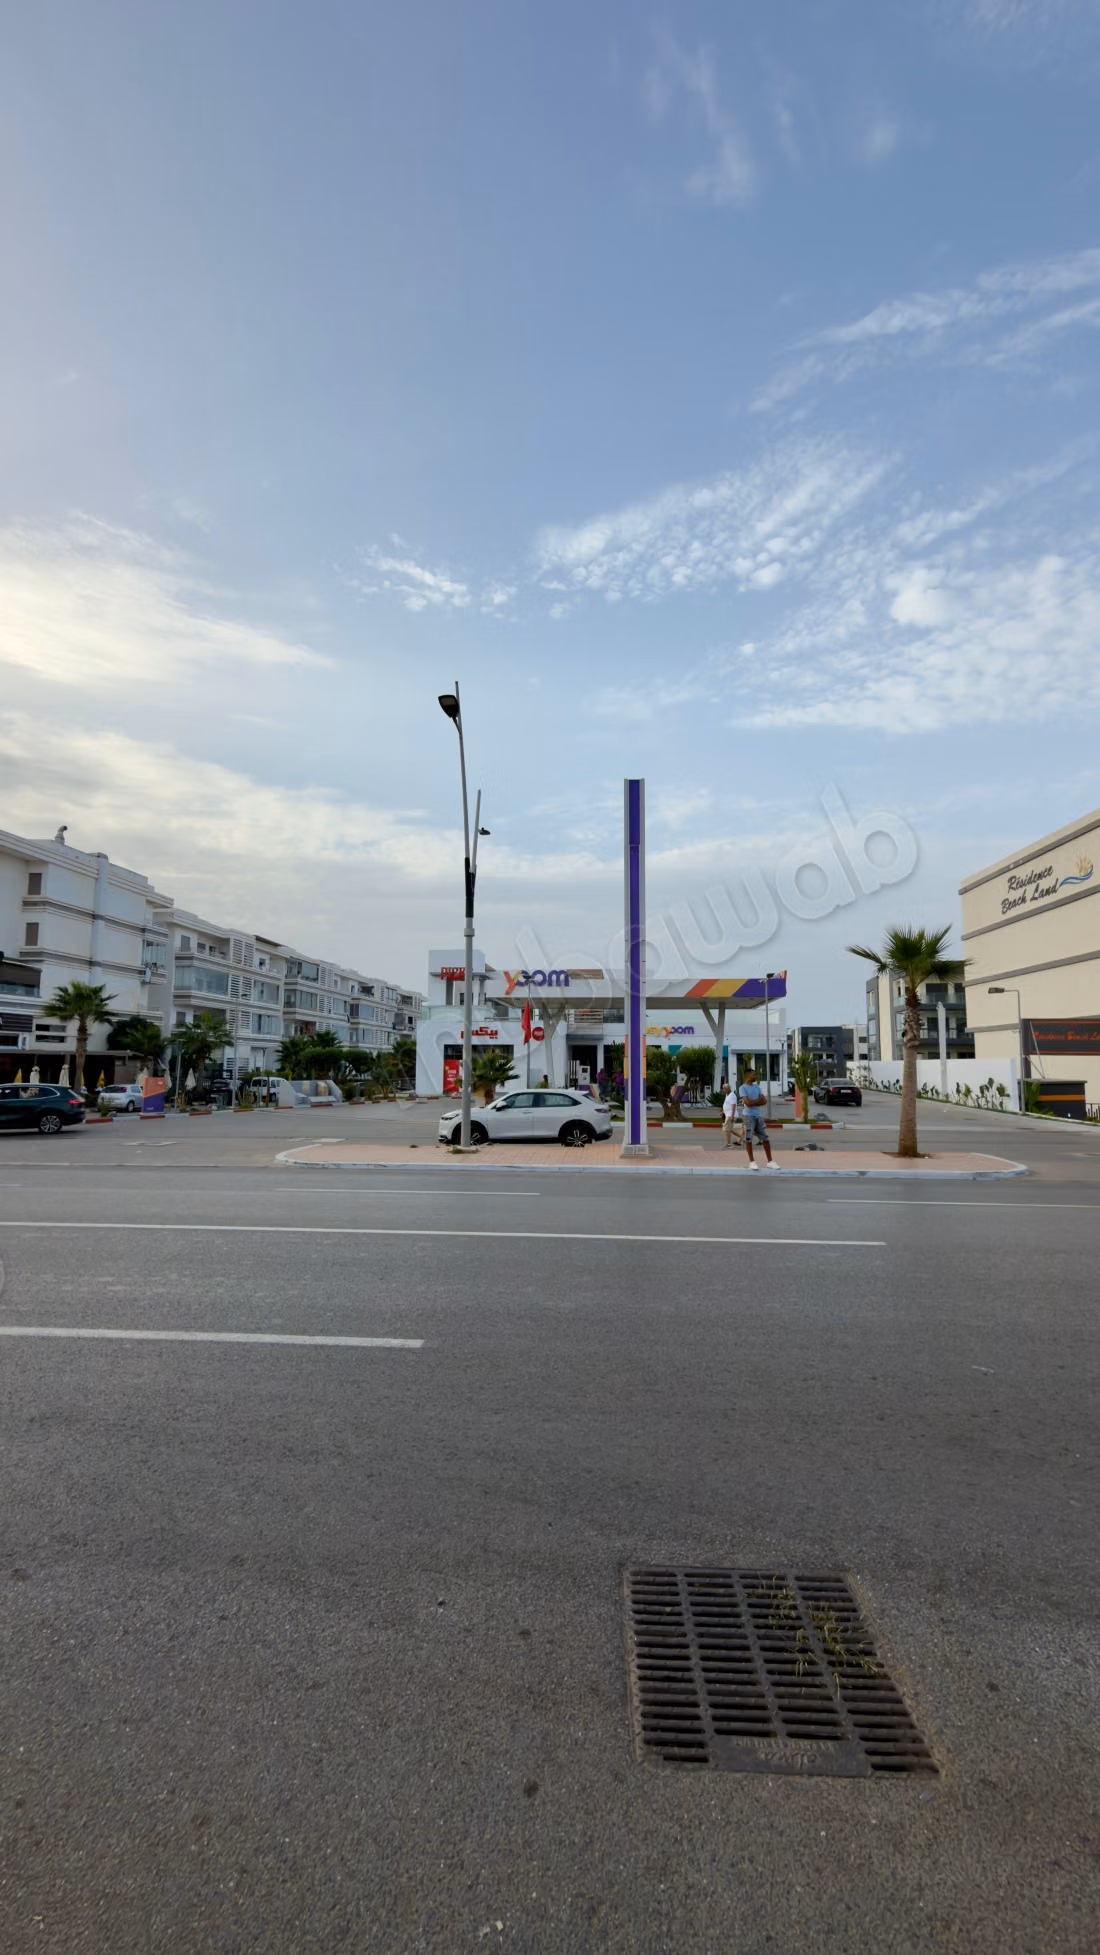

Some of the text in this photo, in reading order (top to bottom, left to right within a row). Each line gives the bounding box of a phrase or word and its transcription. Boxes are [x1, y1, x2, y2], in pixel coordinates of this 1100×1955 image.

[1007, 865, 1054, 893] Résidence
[1001, 877, 1059, 915] Beach Land
[503, 969, 570, 995] yoom
